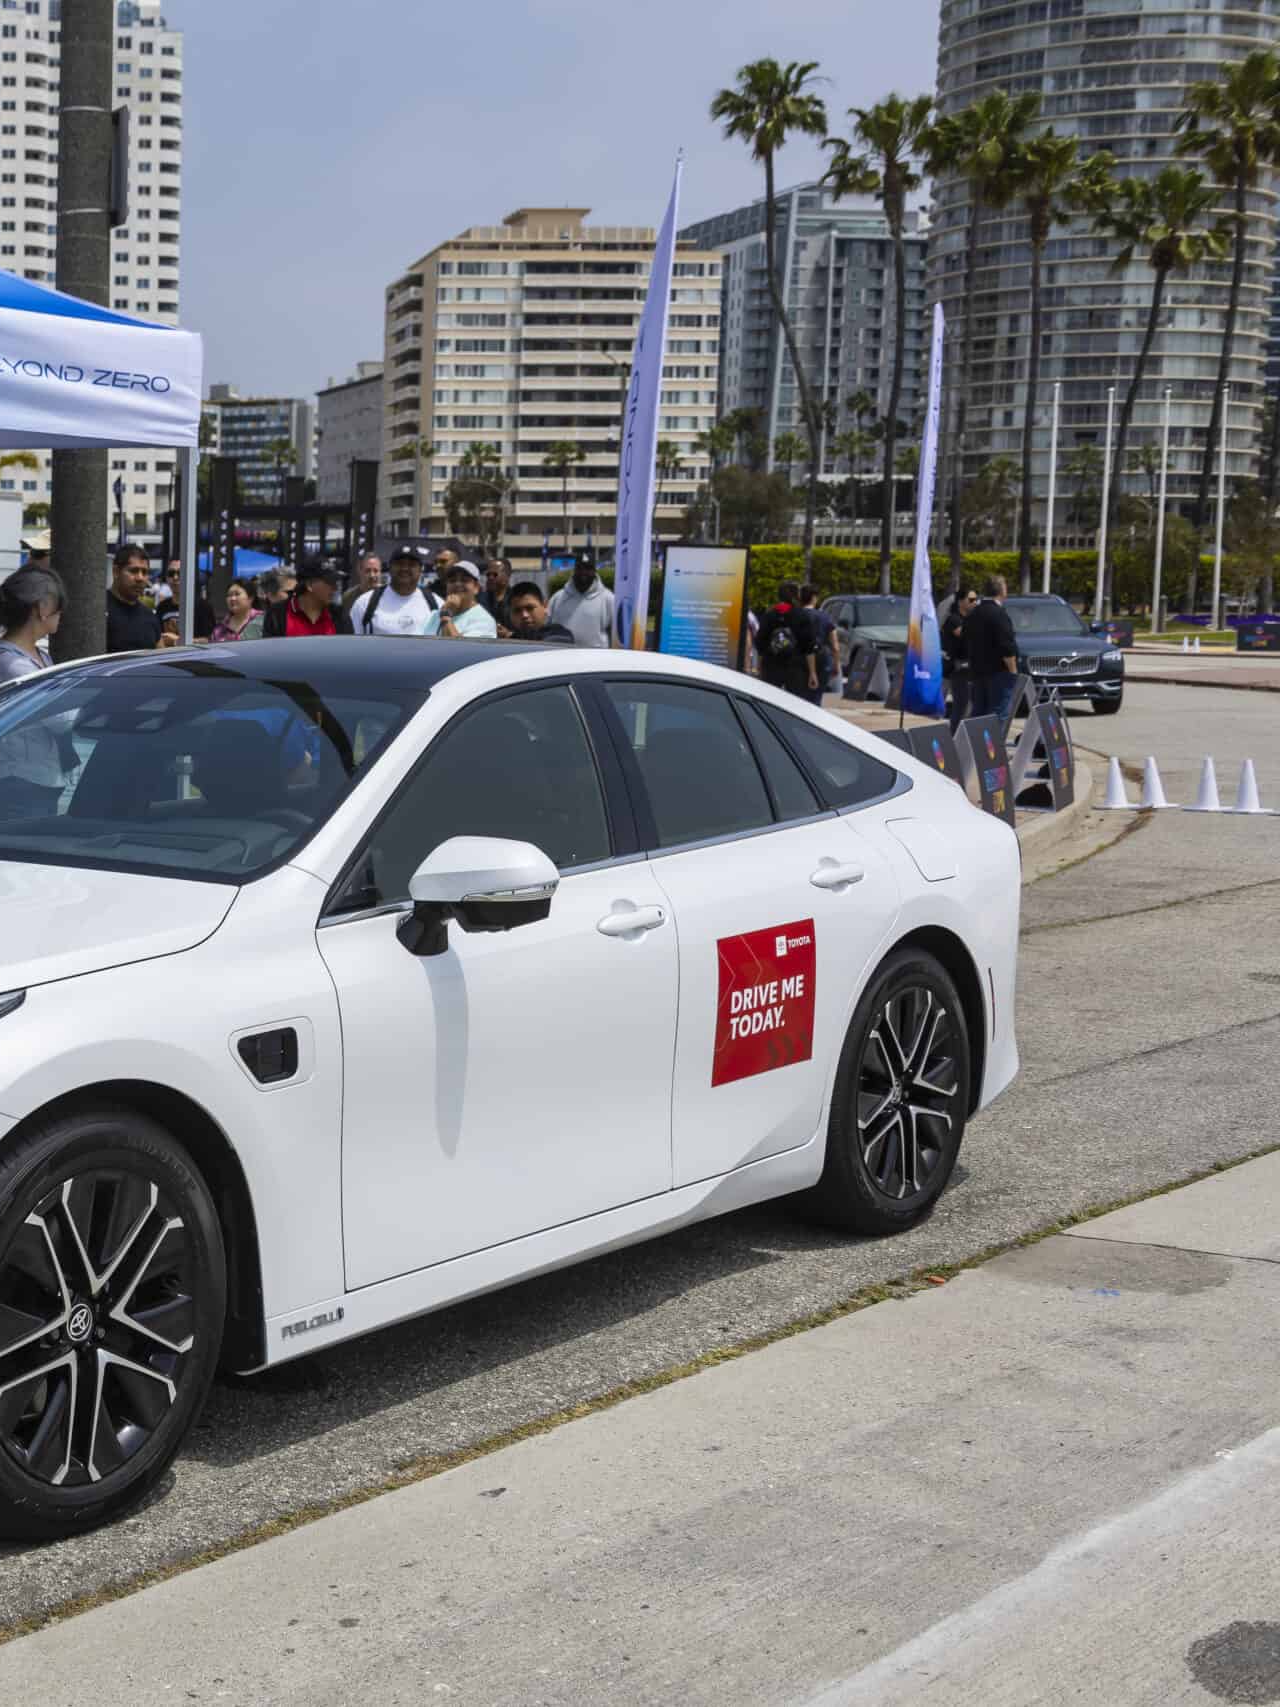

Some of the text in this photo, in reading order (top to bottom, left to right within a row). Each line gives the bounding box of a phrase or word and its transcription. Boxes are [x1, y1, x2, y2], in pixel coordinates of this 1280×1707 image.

[92, 368, 171, 393] ZERO
[787, 935, 811, 949] TOYOTA
[730, 974, 805, 1014] DRIVE ME
[729, 1005, 786, 1040] TODAY.
